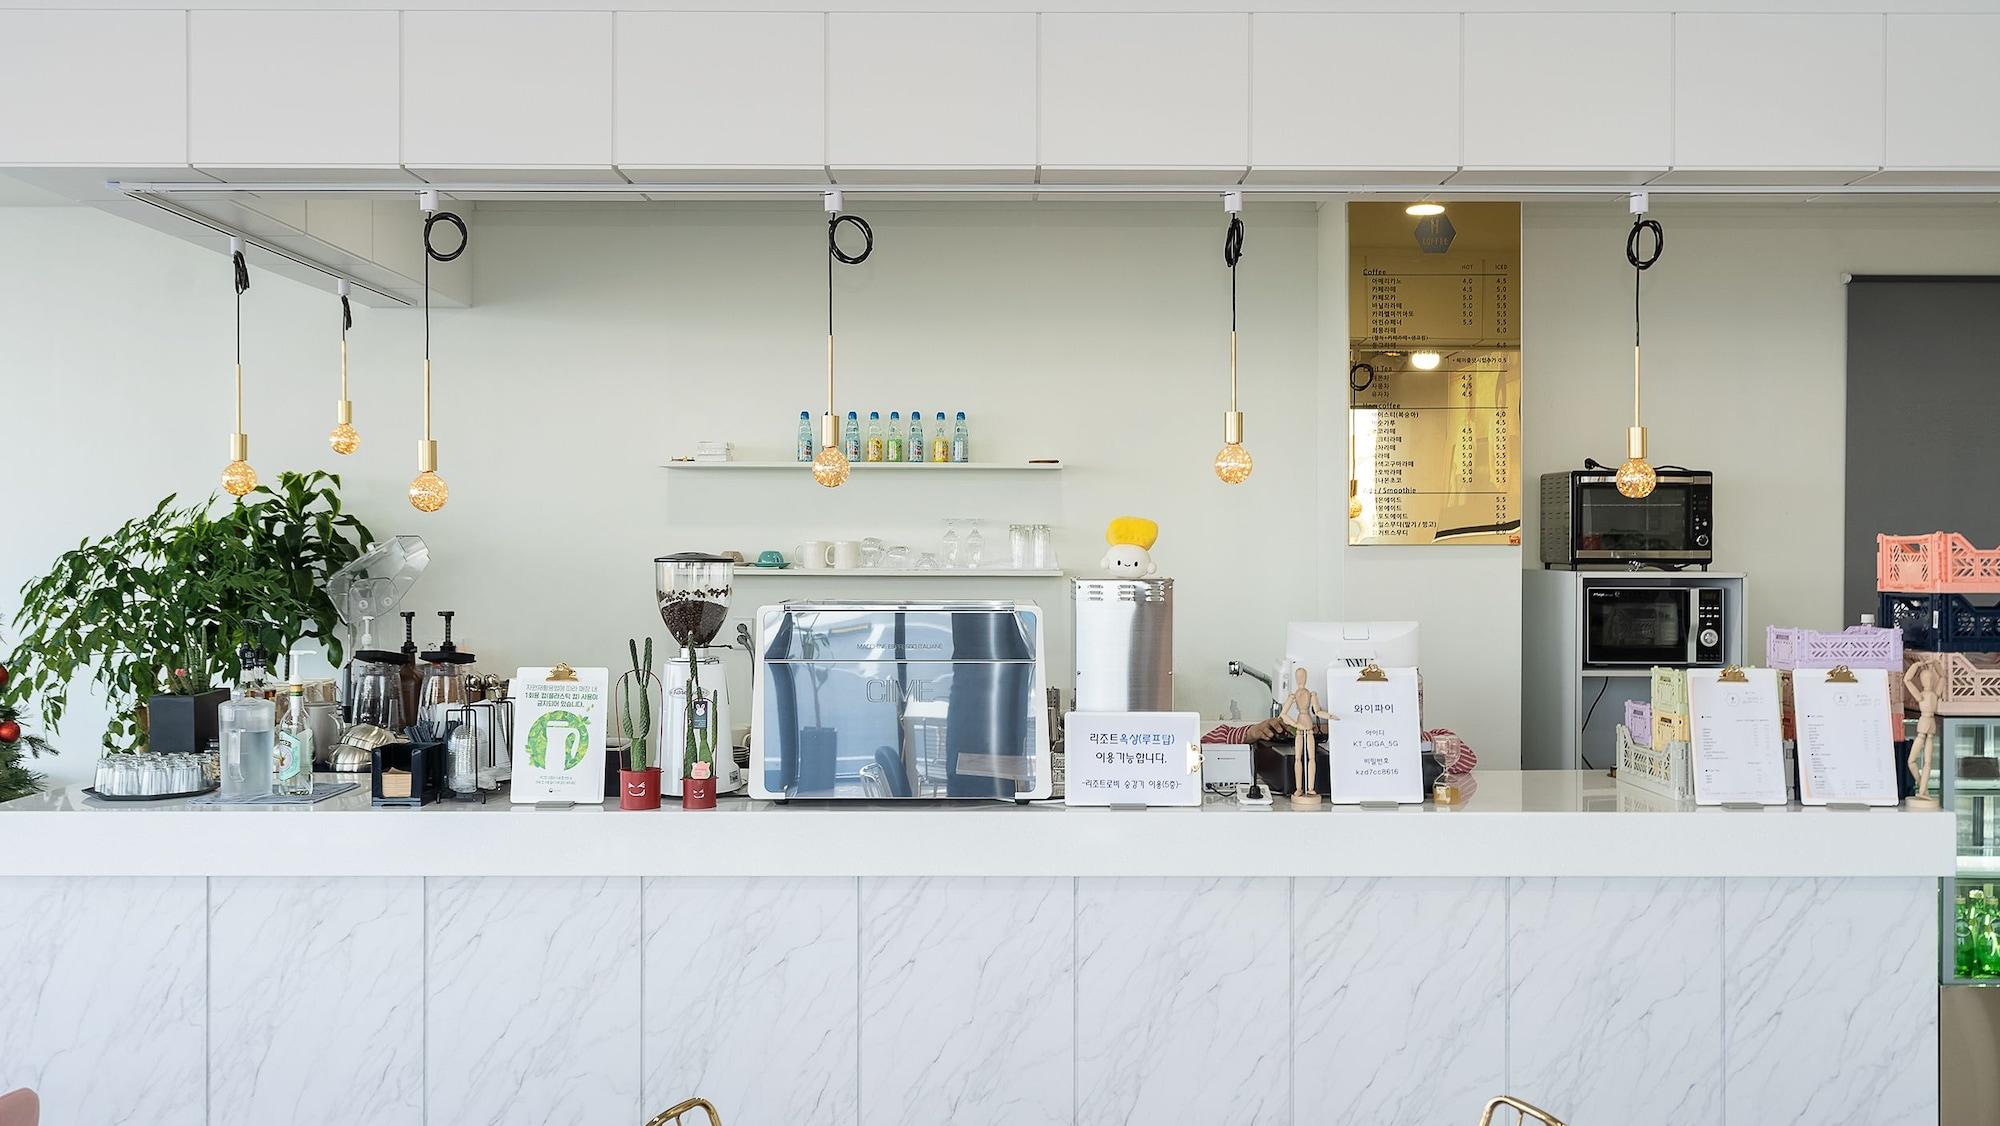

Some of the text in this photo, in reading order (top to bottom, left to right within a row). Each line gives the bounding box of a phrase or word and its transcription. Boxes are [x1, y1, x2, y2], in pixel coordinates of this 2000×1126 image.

[1353, 704, 1394, 714] 와이파이
[1353, 740, 1398, 748] KT_GIGA_5G
[1124, 780, 1145, 789] 승강기
